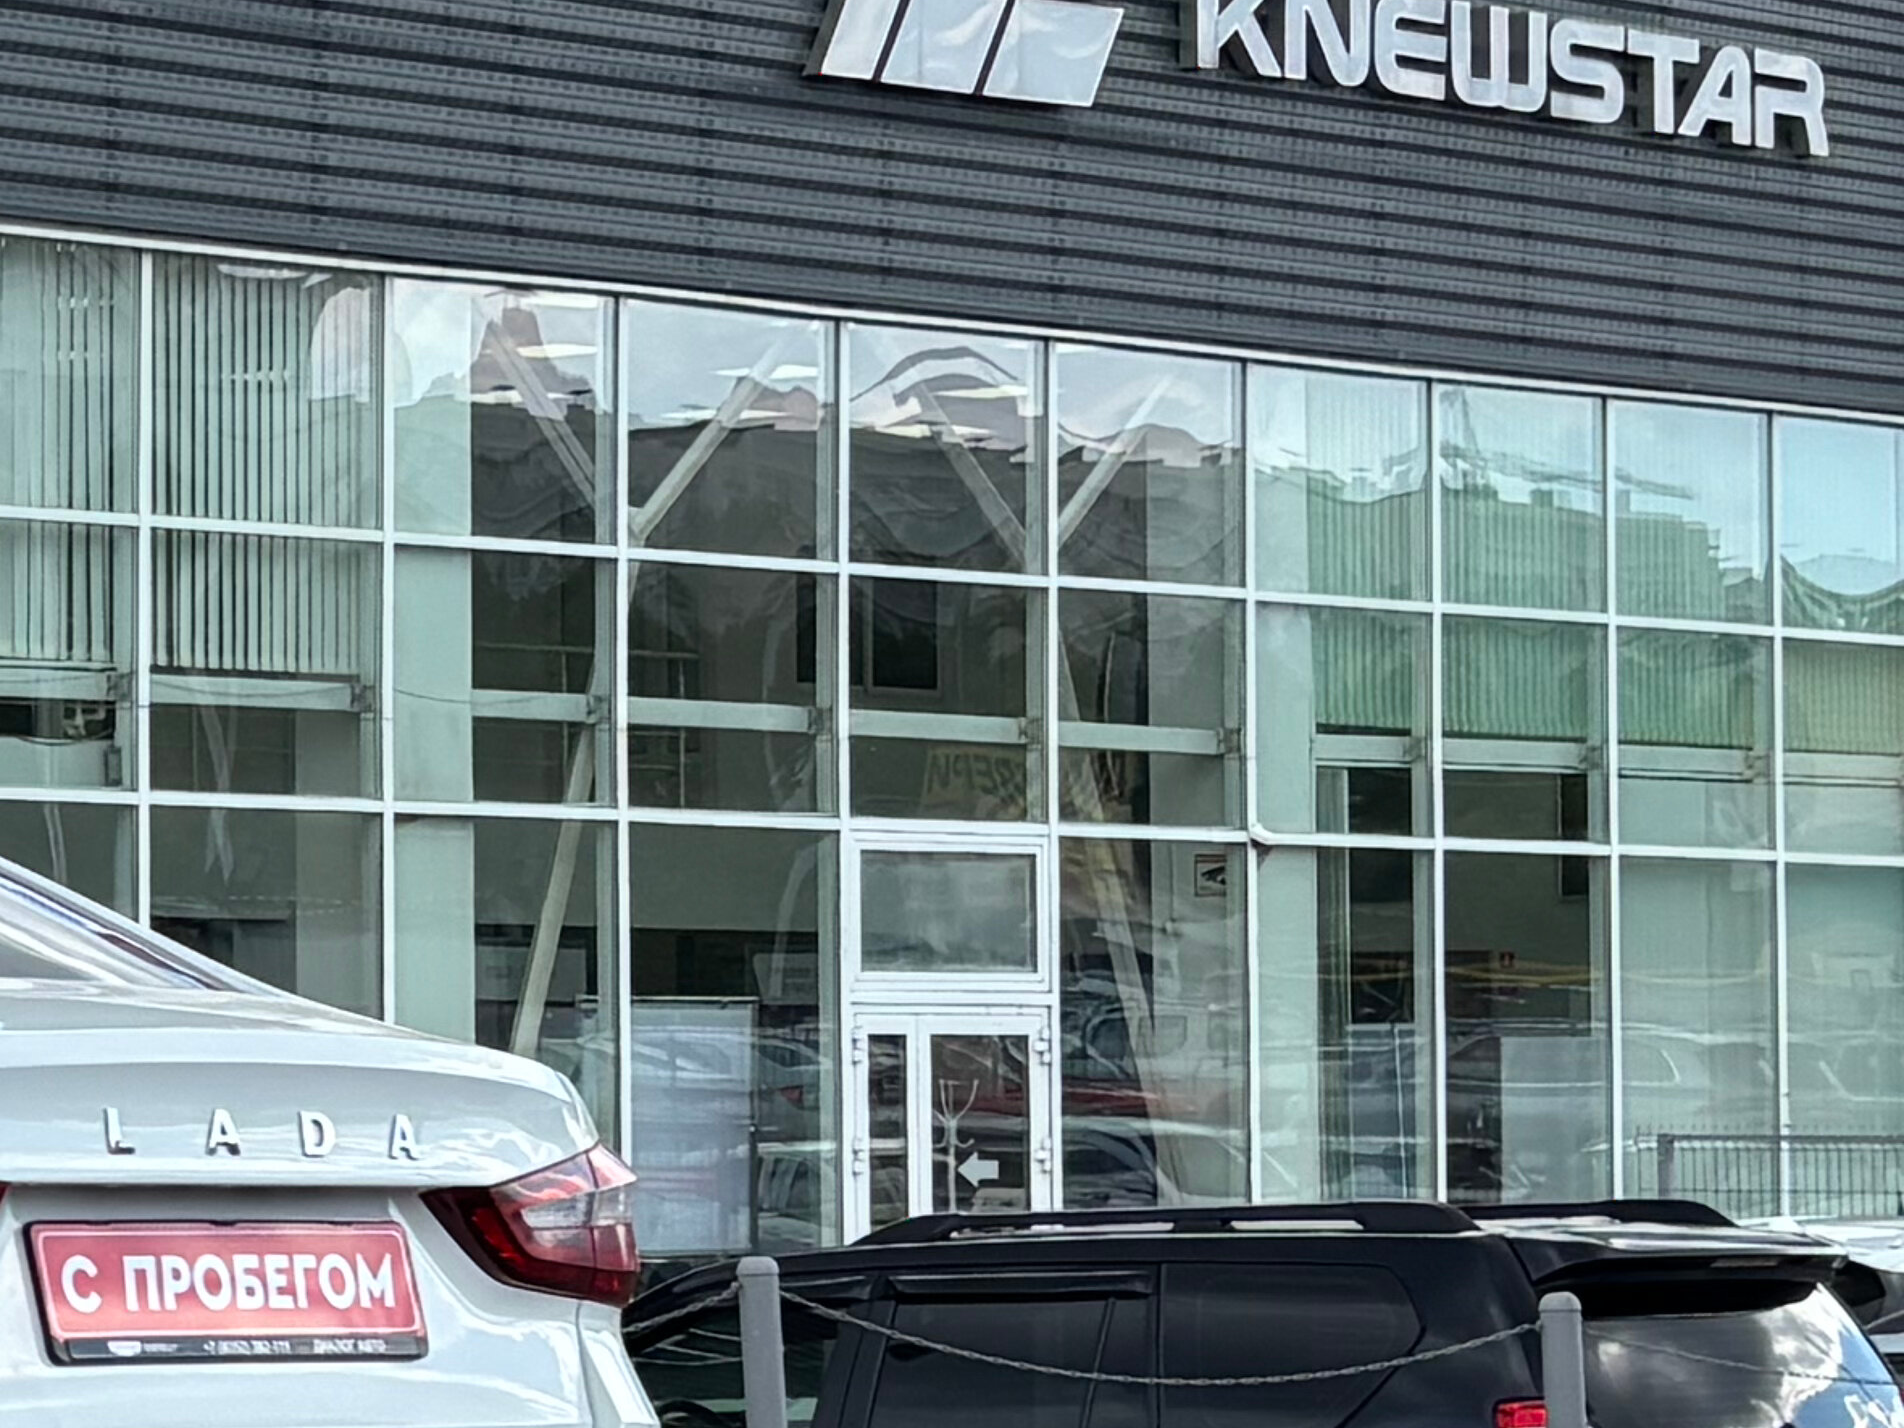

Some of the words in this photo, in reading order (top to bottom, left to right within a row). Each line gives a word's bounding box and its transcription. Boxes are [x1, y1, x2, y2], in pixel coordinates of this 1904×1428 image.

[102, 1106, 420, 1161] LADA
[60, 1253, 103, 1314] С
[122, 1252, 396, 1312] ПРОБЕГОМ
